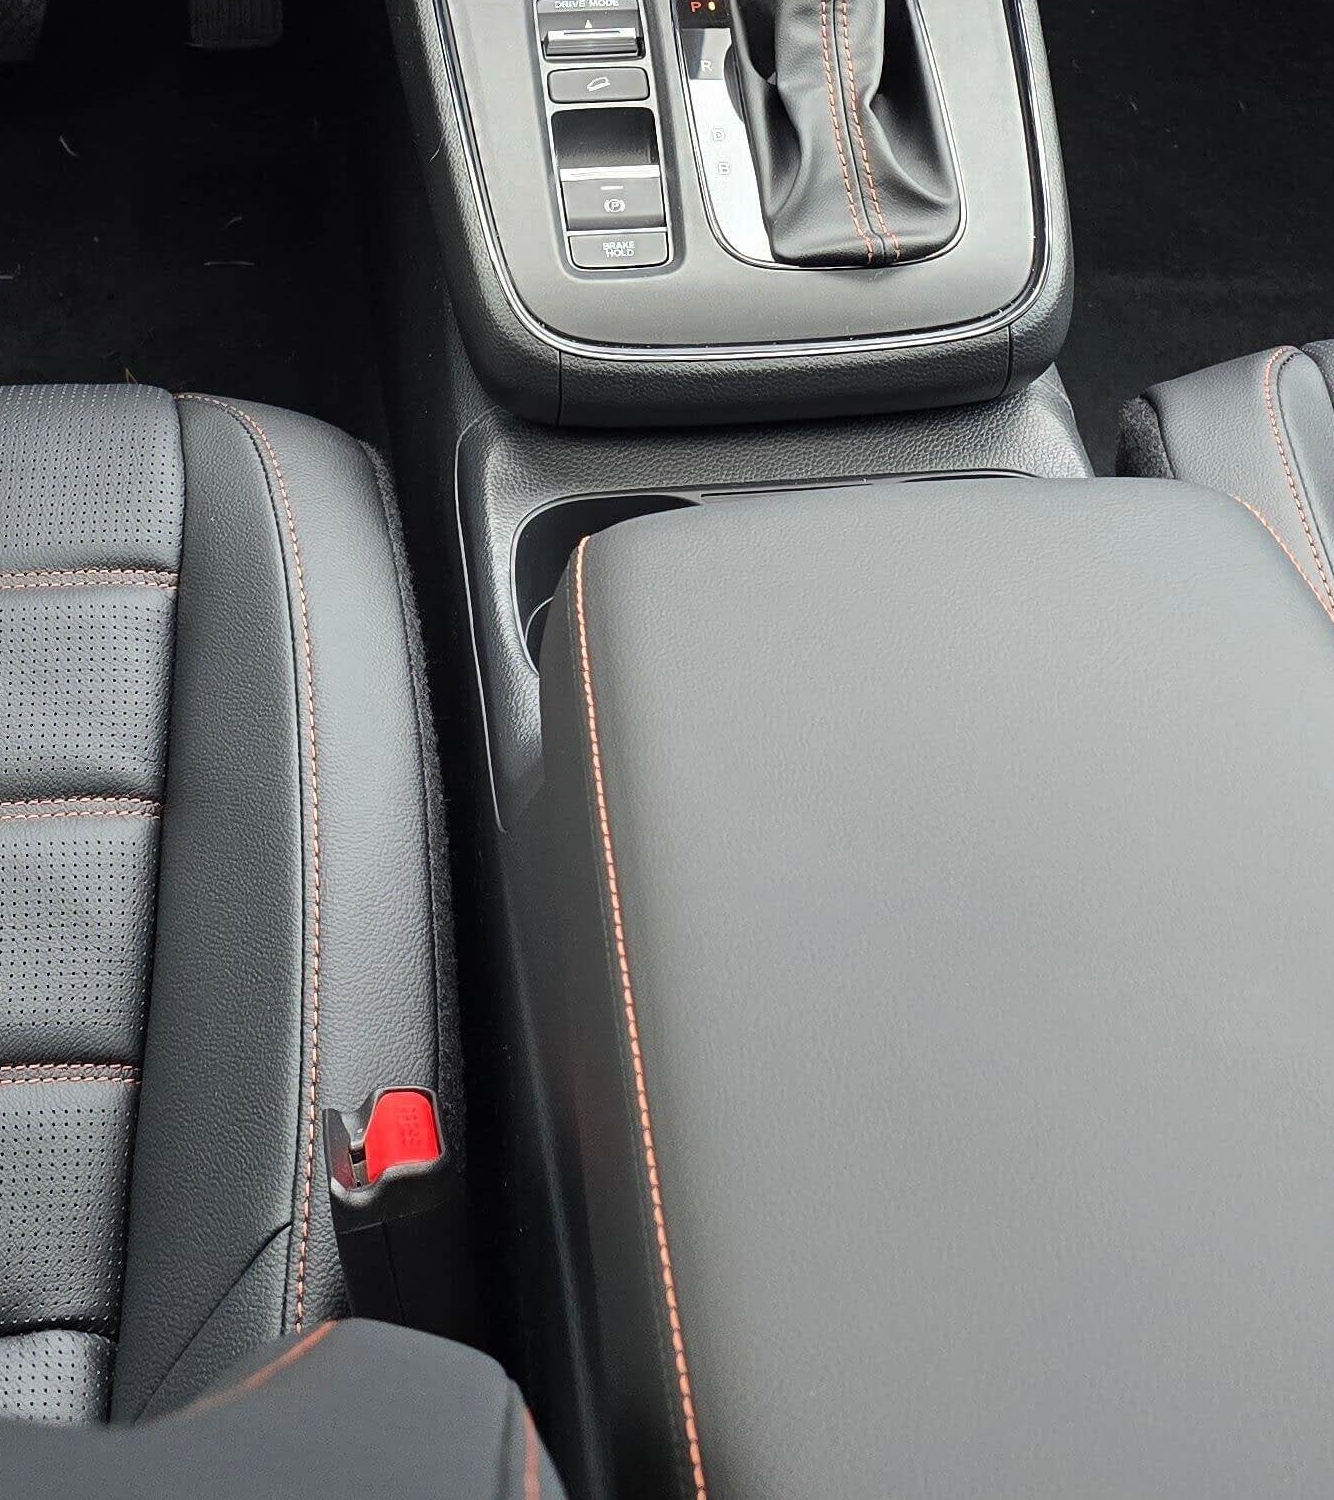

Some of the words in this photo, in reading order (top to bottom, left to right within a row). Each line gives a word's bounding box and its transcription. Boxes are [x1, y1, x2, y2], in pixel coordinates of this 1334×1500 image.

[554, 0, 585, 9] DRIVE
[589, 0, 619, 8] MODE
[690, 1, 702, 12] P
[700, 59, 713, 71] R
[713, 128, 725, 141] D
[718, 162, 731, 175] B
[603, 241, 635, 250] BRAKE
[606, 249, 635, 258] HOLD
